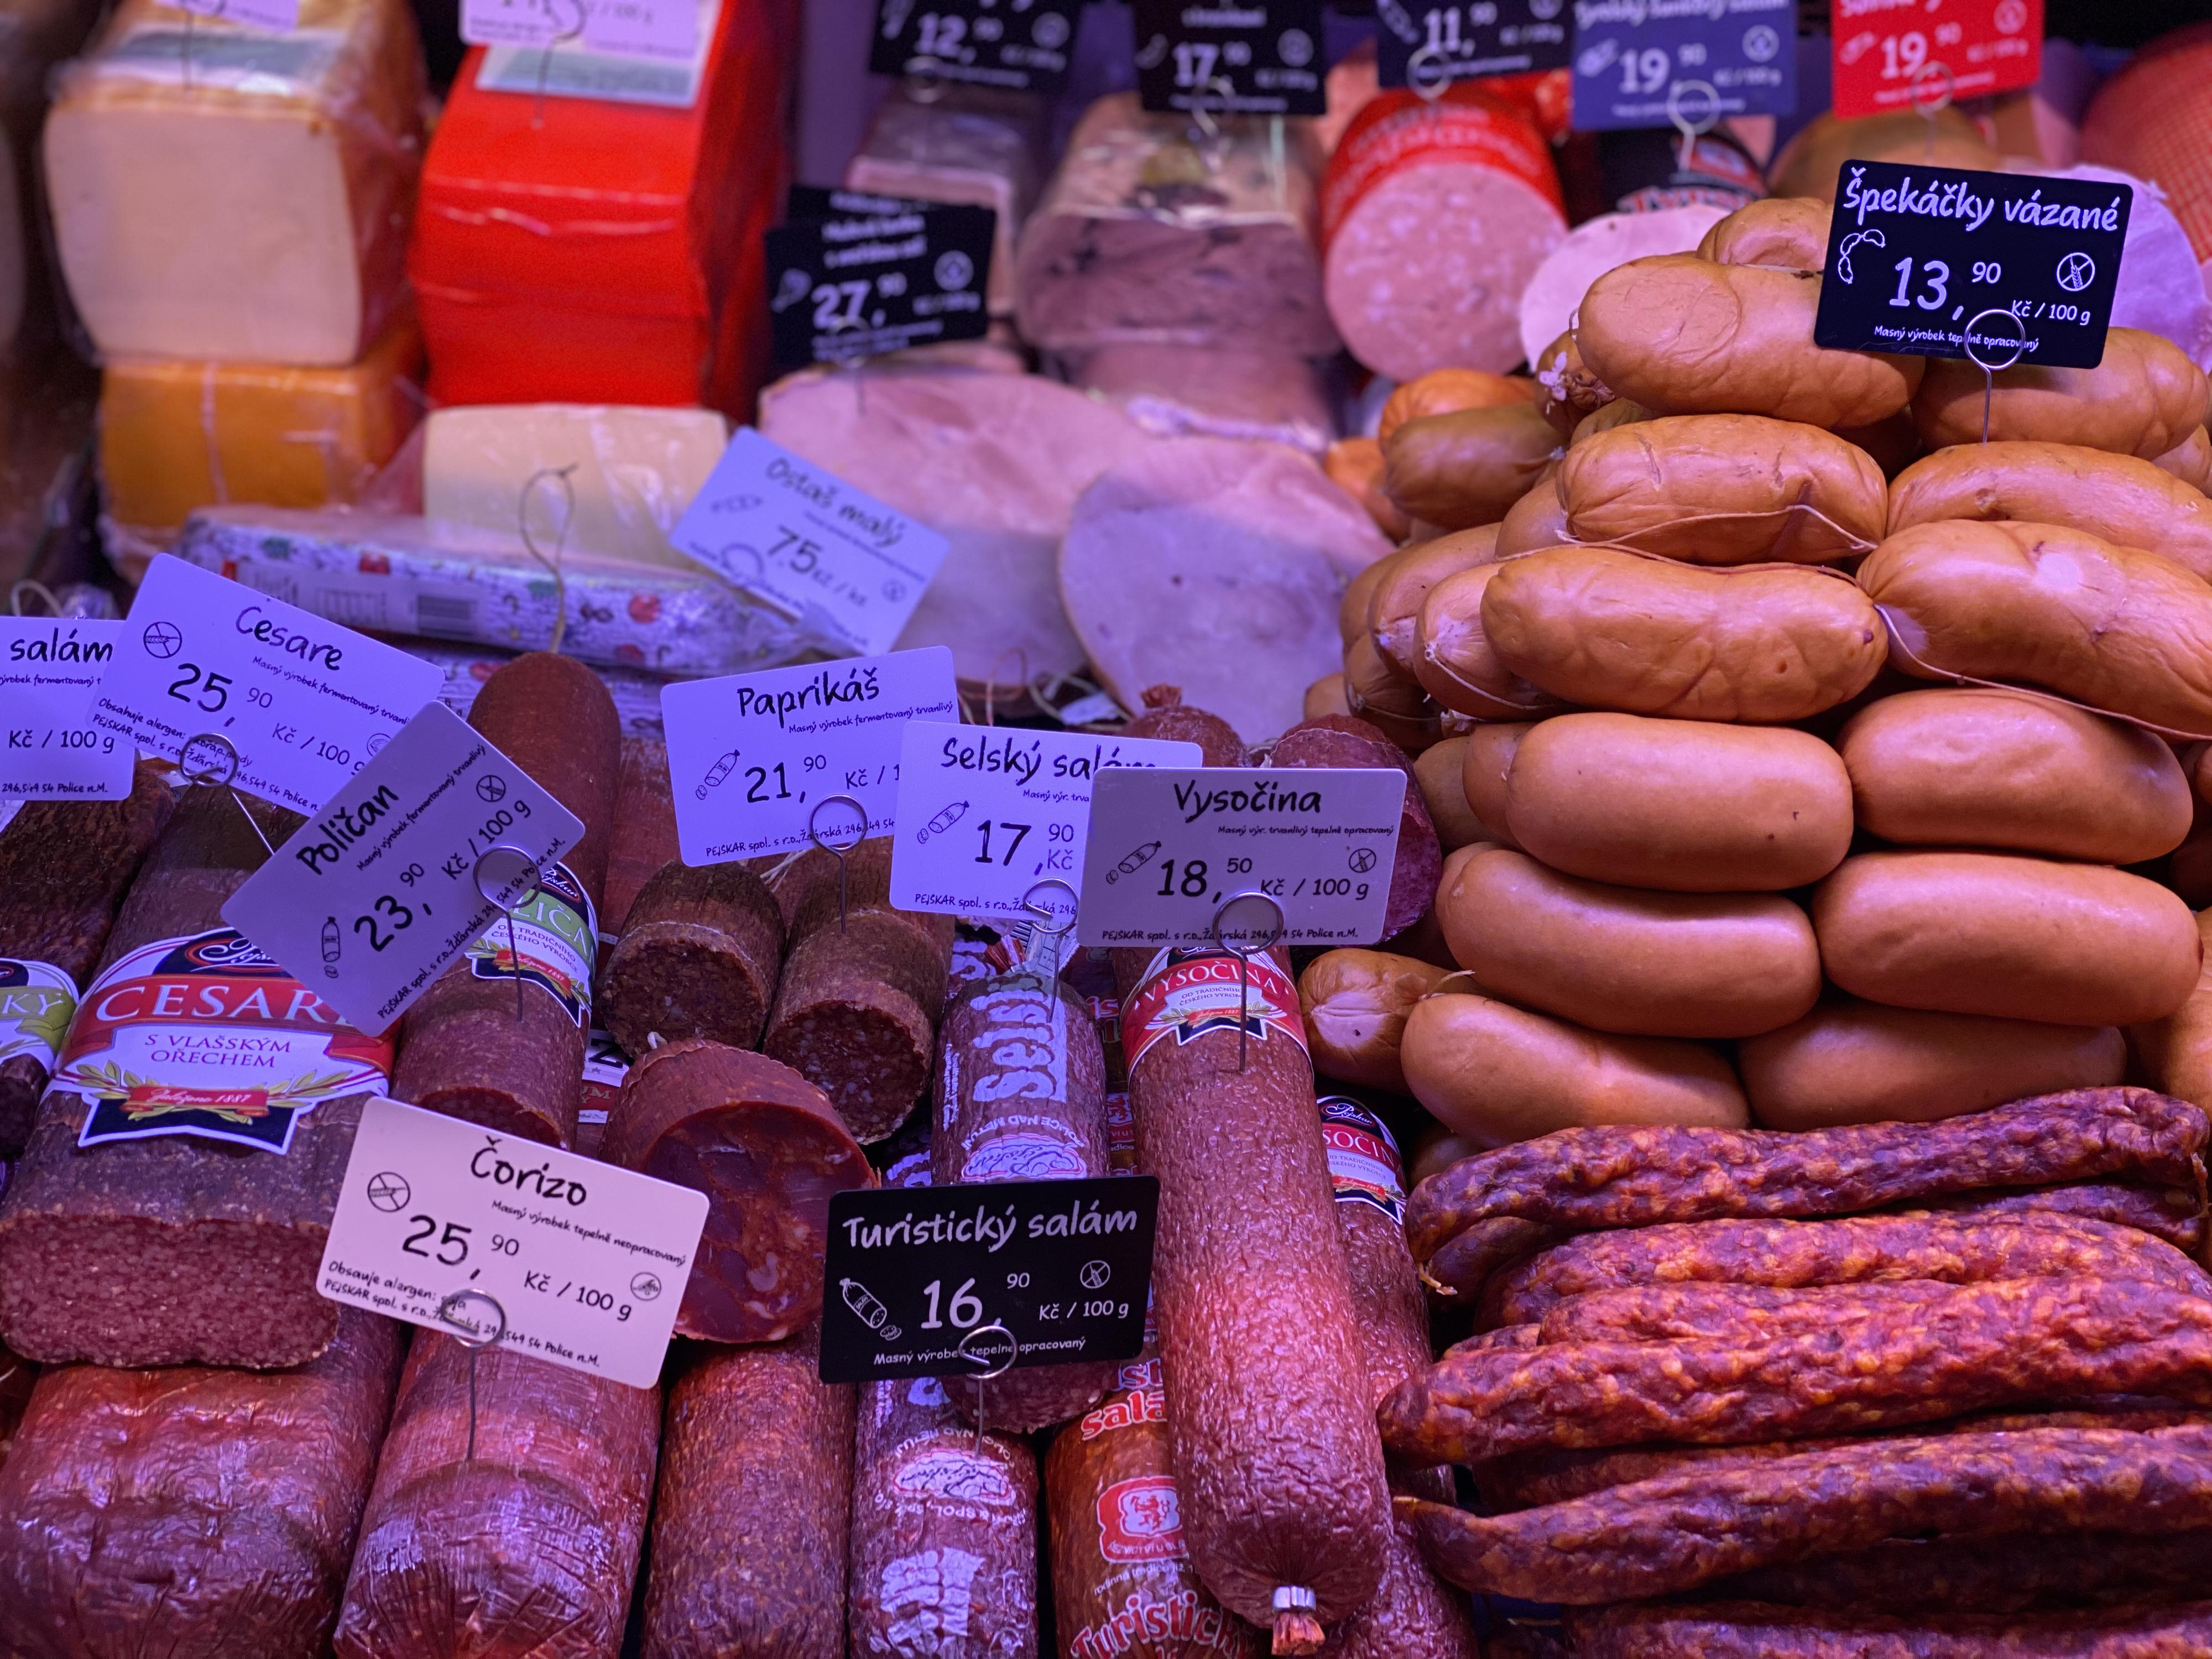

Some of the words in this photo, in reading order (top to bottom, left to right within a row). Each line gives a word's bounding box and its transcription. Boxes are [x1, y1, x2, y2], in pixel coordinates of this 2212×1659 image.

[1843, 167, 1994, 232] Špekáčky
[2005, 190, 2120, 231] vázané
[1971, 262, 2001, 283] 90
[2011, 300, 2031, 317] Kč
[2034, 302, 2046, 318] /
[2049, 304, 2078, 321] 100
[2080, 311, 2091, 325] g
[1874, 326, 1906, 341] Masný
[1907, 327, 1945, 341] výrobek
[1948, 332, 1981, 346] teplně
[768, 525, 823, 573] 75
[10, 627, 113, 663] salám
[235, 606, 343, 671] Cesare
[34, 674, 95, 687] fermentovaný
[253, 656, 282, 676] Masný
[284, 670, 317, 689] výrobek
[319, 682, 379, 715] fermentovaný
[247, 687, 273, 708] 90
[737, 667, 880, 729] Paprikáš
[98, 698, 144, 723] Obsahuje
[789, 721, 817, 734] Masný
[819, 717, 853, 732] výrobek
[854, 707, 914, 727] fermentovaný
[916, 701, 953, 717] trvanlivý
[9, 729, 33, 748] Kč
[41, 729, 53, 748] /
[60, 730, 97, 748] 100
[103, 737, 115, 754] g
[272, 723, 297, 743] Kč
[300, 736, 315, 749] /
[316, 742, 350, 765] 100
[93, 714, 133, 737] PEJSKAR
[134, 733, 155, 748] spol.
[269, 785, 280, 795] 54
[283, 789, 307, 807] Police
[804, 754, 827, 773] 90
[941, 735, 1042, 786] Selský
[42, 784, 54, 793] 54
[58, 783, 84, 793] Police
[845, 769, 868, 789] Kč
[877, 765, 886, 785] /
[357, 846, 382, 871] Masný
[381, 821, 409, 849] výrobek
[406, 774, 455, 823] fermentovaný
[453, 744, 486, 775] trvanlivý
[1023, 789, 1051, 802] Masný
[1174, 779, 1321, 823] Vysočina
[296, 785, 399, 875] Poličan
[441, 853, 468, 880] Kč
[478, 810, 514, 844] 100
[514, 800, 531, 818] g
[706, 842, 746, 857] PEJSKAR
[749, 836, 771, 853] spol.
[884, 818, 895, 829] 54
[1048, 823, 1074, 842] 90
[1218, 825, 1246, 837] Masný
[1269, 825, 1308, 837] trvanlivý
[1311, 825, 1342, 837] tepelně
[1344, 825, 1394, 837] opracovaný
[1046, 848, 1073, 870] Kč
[1227, 857, 1253, 873] 50
[400, 863, 424, 886] 90
[915, 894, 956, 906] PEJSKAR
[958, 896, 981, 910] spol.
[1260, 879, 1285, 896] Kč
[1292, 878, 1306, 896] /
[1312, 878, 1351, 896] 100
[1357, 883, 1369, 901] g
[377, 984, 413, 1019] PEJSKAR
[511, 877, 524, 890] 54
[521, 855, 547, 878] Poce
[1102, 930, 1144, 941] PEJSKAR
[1147, 930, 1172, 942] spol.
[1291, 930, 1303, 939] 54
[1307, 928, 1333, 939] Police
[96, 984, 354, 1026] CESAR
[144, 1034, 157, 1046] S
[168, 1033, 291, 1053] VLAŠSKÝM
[151, 1047, 275, 1068] OŘECHEM
[216, 1093, 252, 1104] 1887
[470, 1135, 587, 1207] Čorizo
[492, 1199, 526, 1220] Masný
[529, 1212, 570, 1232] výrobek
[574, 1224, 611, 1244] tepelně
[614, 1237, 686, 1268] neopracovaný
[843, 1204, 1018, 1253] Turistický
[1029, 1199, 1137, 1238] salám
[491, 1234, 519, 1256] 90
[1007, 1272, 1030, 1288] 90
[524, 1270, 551, 1292] Kč
[556, 1282, 572, 1297] /
[576, 1286, 614, 1311] 100
[617, 1305, 632, 1322] g
[325, 1278, 370, 1301] PEJSKAR
[528, 1337, 541, 1349] 54
[545, 1341, 573, 1359] Police
[1039, 1303, 1059, 1321] Kč
[1067, 1302, 1077, 1318] /
[1083, 1300, 1114, 1317] 100
[1118, 1303, 1129, 1318] g
[874, 1349, 914, 1365] Masný
[917, 1348, 966, 1362] výrobe
[1019, 1336, 1087, 1353] opracovaný
